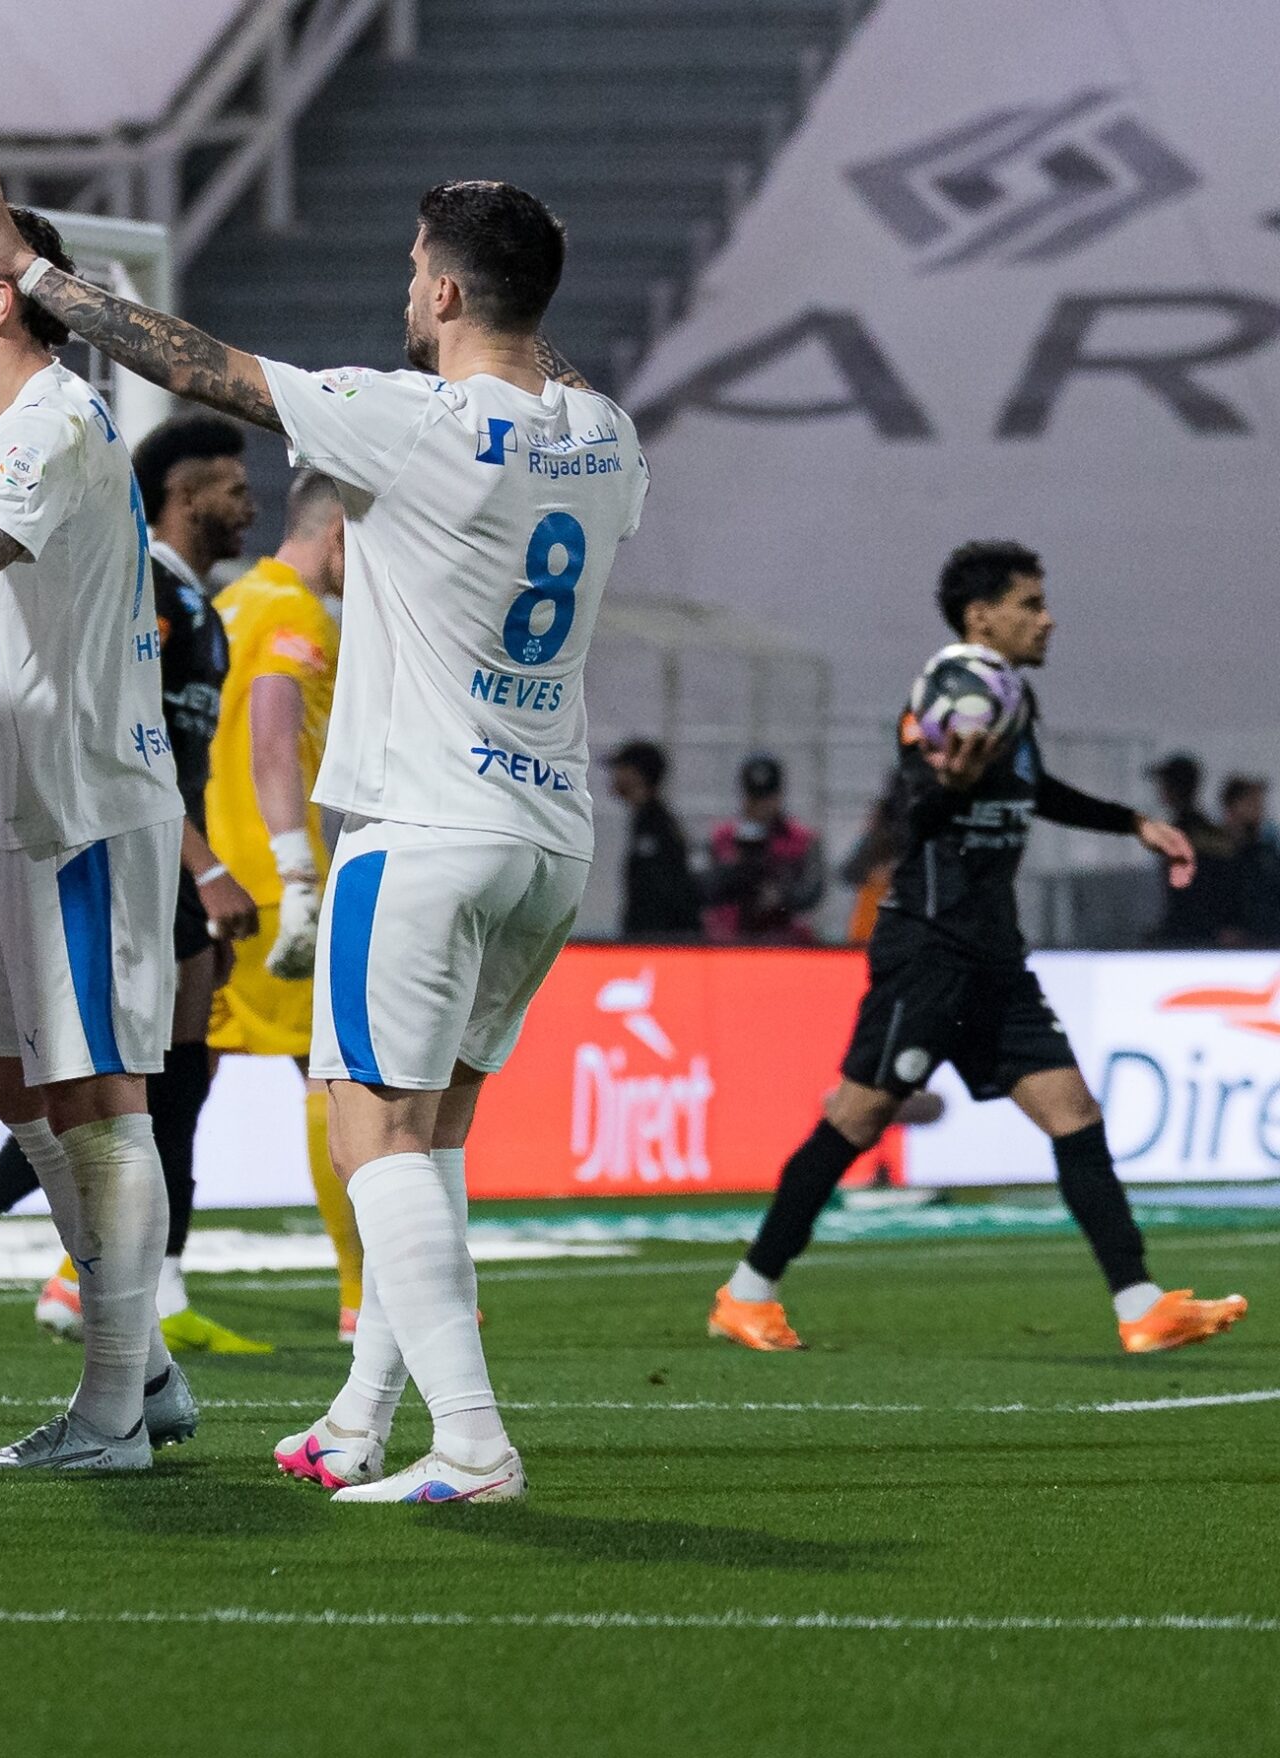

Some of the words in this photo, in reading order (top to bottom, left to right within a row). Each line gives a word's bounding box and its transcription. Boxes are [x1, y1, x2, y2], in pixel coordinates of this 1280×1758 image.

[529, 451, 581, 480] Riyad
[586, 452, 623, 475] Bank
[502, 511, 587, 666] 8
[471, 669, 564, 712] NEVES
[571, 1042, 714, 1182] Direct
